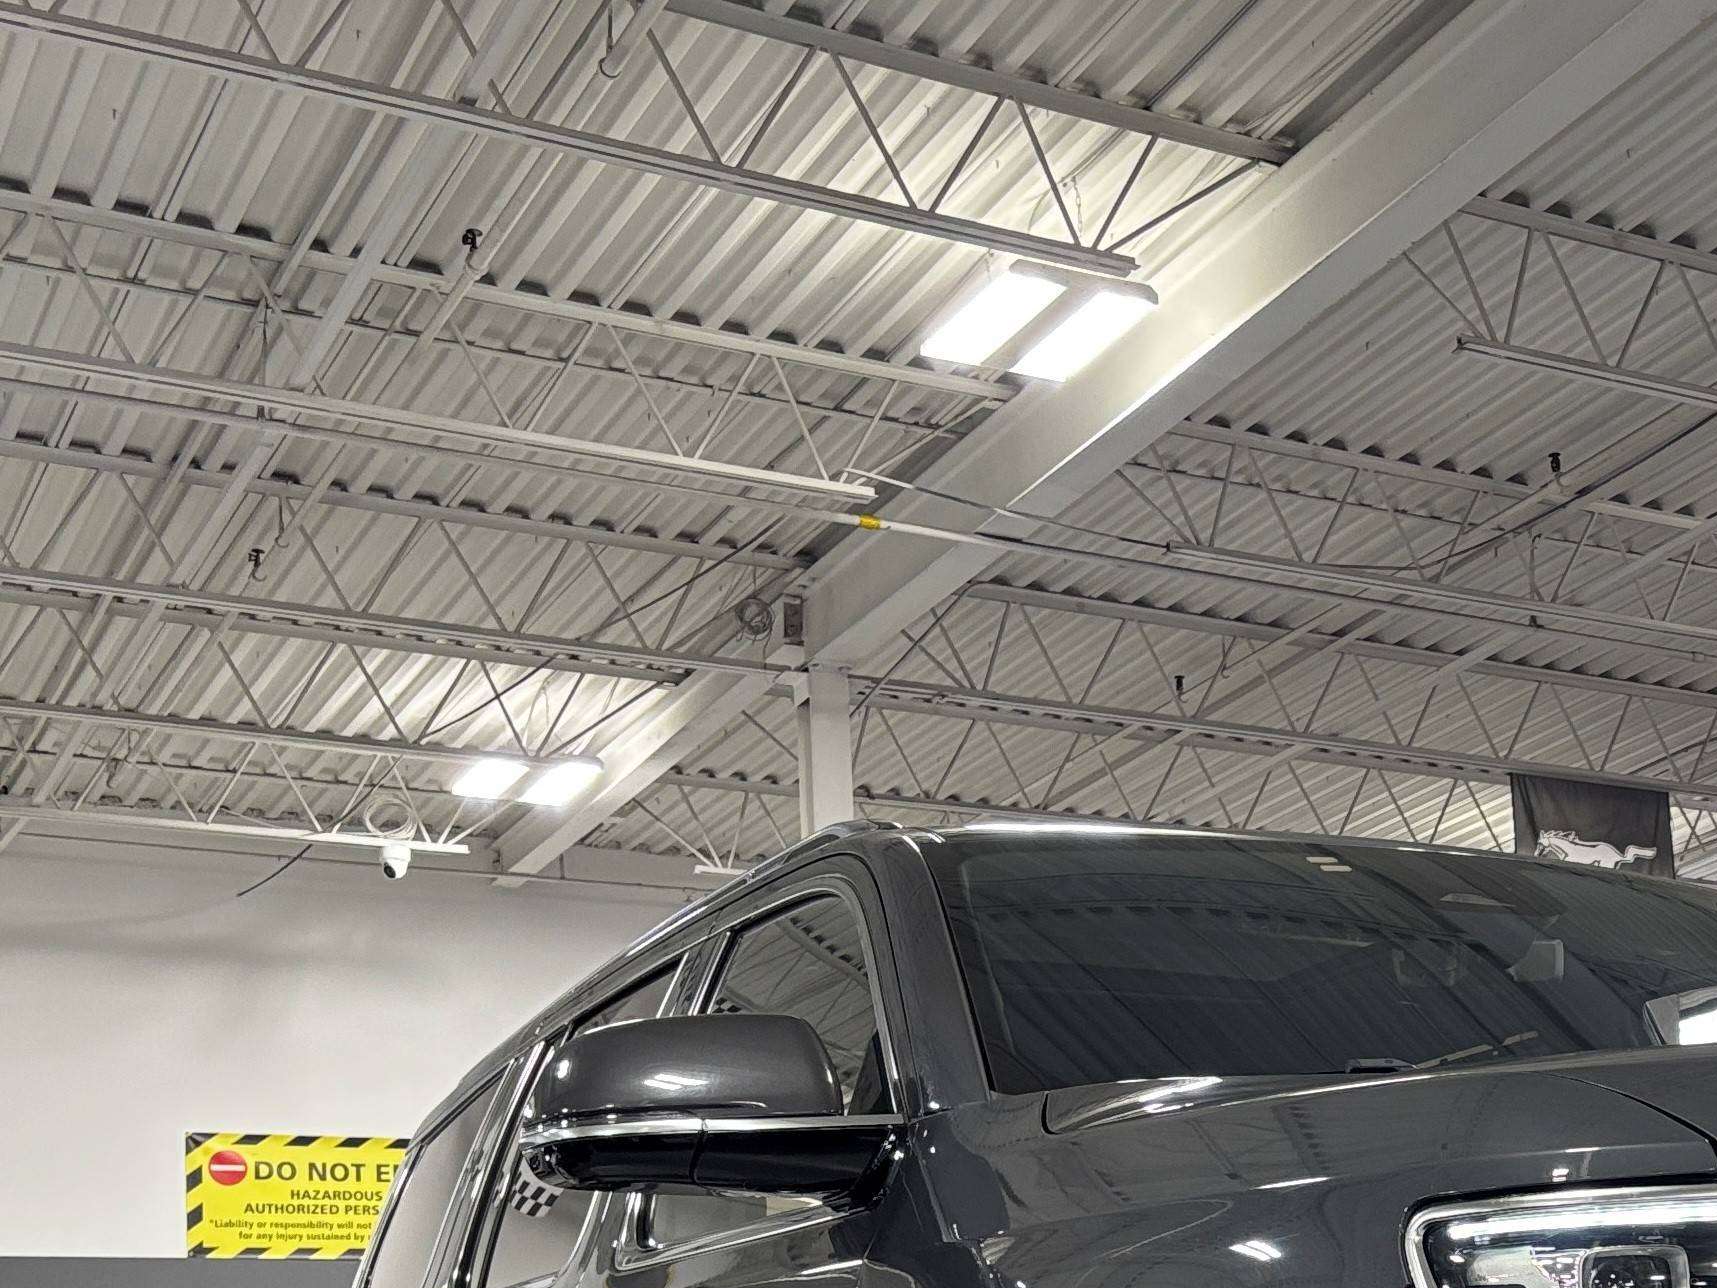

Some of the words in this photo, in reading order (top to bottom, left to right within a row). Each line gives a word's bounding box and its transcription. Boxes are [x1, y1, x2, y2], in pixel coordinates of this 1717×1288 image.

[254, 1161, 297, 1181] DO
[308, 1162, 366, 1183] NOT
[376, 1163, 399, 1183] E
[290, 1189, 383, 1201] HAZARDOUS
[244, 1203, 339, 1215] AUTHORIZED
[269, 1220, 334, 1231] responsibility
[337, 1221, 353, 1230] will
[356, 1221, 372, 1230] not
[239, 1231, 253, 1240] for
[256, 1233, 273, 1242] any
[276, 1232, 303, 1242] injury
[306, 1232, 352, 1241] sustained
